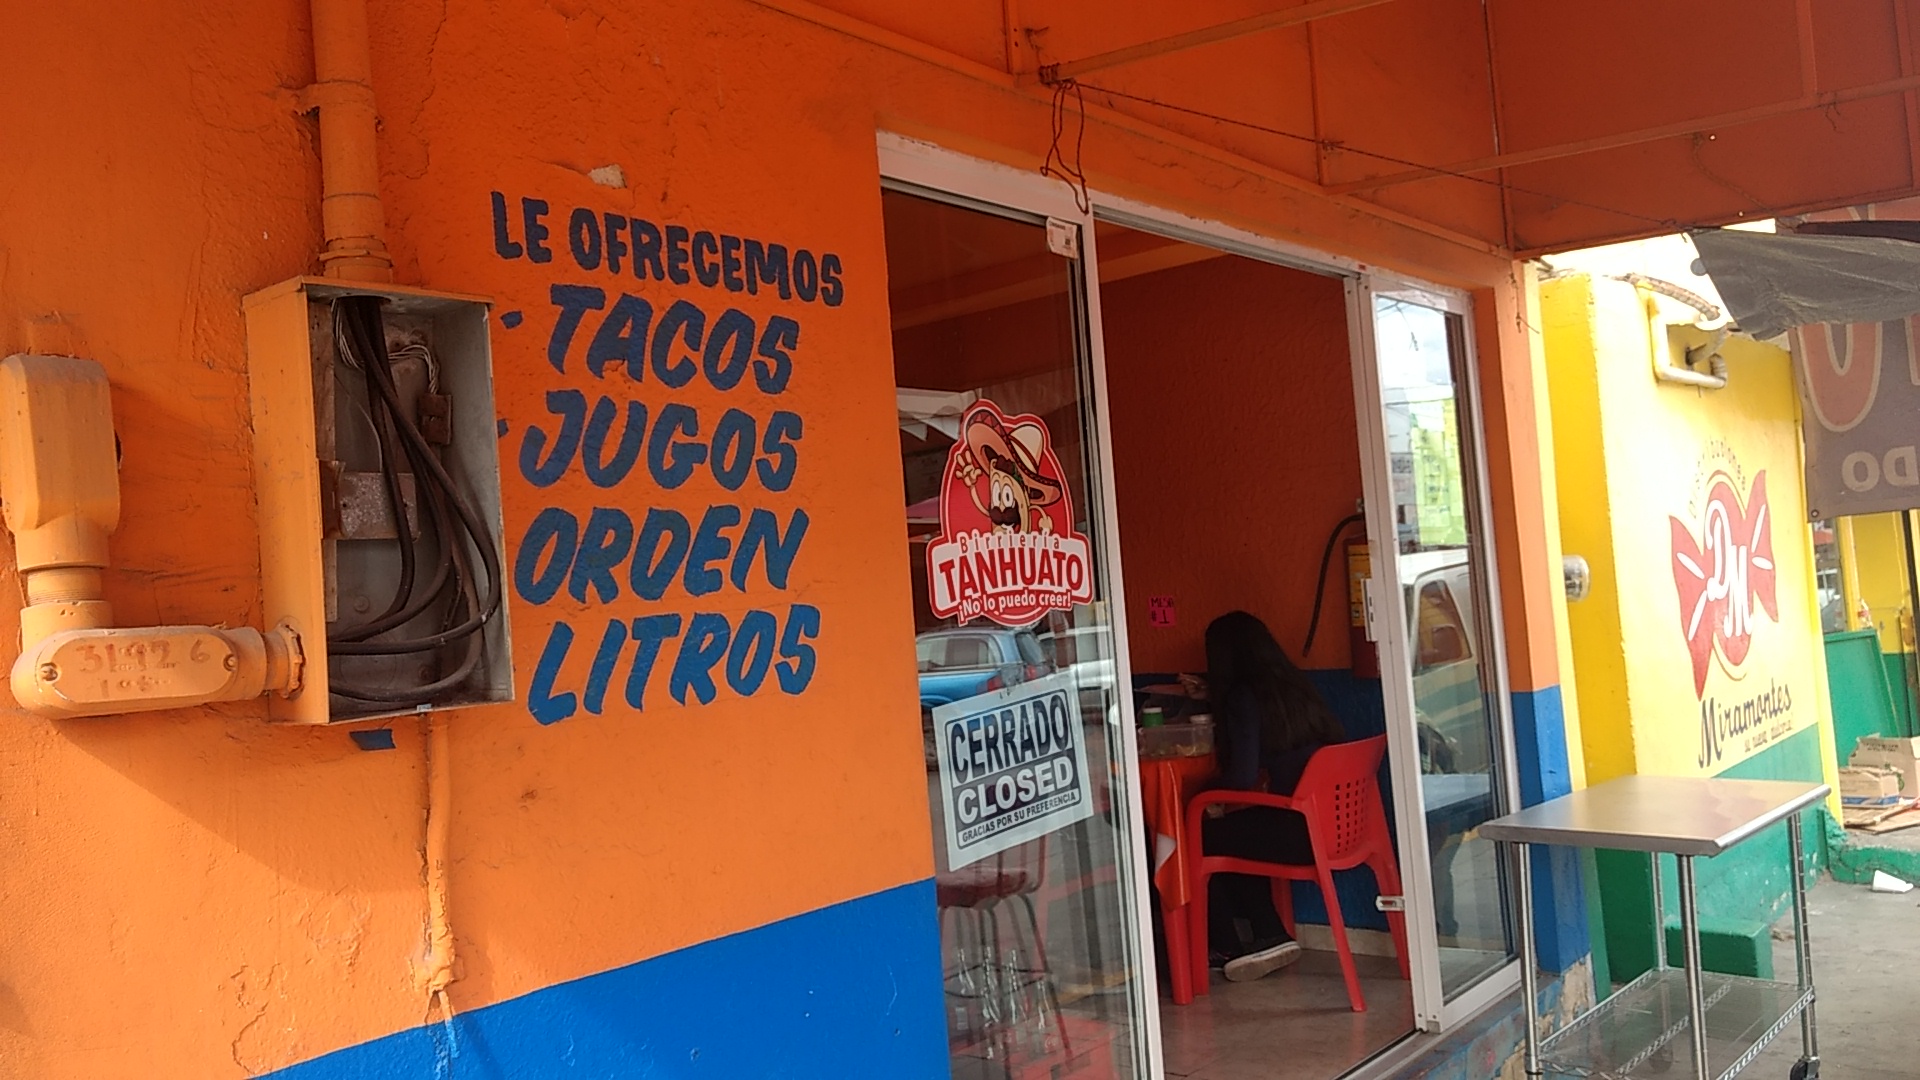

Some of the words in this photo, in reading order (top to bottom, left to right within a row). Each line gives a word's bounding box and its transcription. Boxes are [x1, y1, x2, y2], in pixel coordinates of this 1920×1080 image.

[491, 191, 552, 264] LE
[569, 208, 844, 307] OFRECEMOS
[548, 284, 800, 394] TACOS
[519, 389, 804, 493] JUGOS
[514, 504, 810, 606] ORDEN
[938, 547, 1084, 604] TANHUATO
[959, 530, 1060, 554] Birriería
[983, 595, 996, 611] lo
[1000, 591, 1037, 613] puedo
[1039, 592, 1072, 608] creer!
[528, 604, 821, 726] LITROS
[950, 694, 1070, 784] CERRADO
[1698, 677, 1792, 769] Miramontes
[957, 756, 1075, 825] CLOSED
[962, 820, 996, 843] GRACIAS
[996, 815, 1013, 829] POR
[1013, 811, 1025, 822] SU
[1026, 791, 1076, 818] PREFERENCIA
